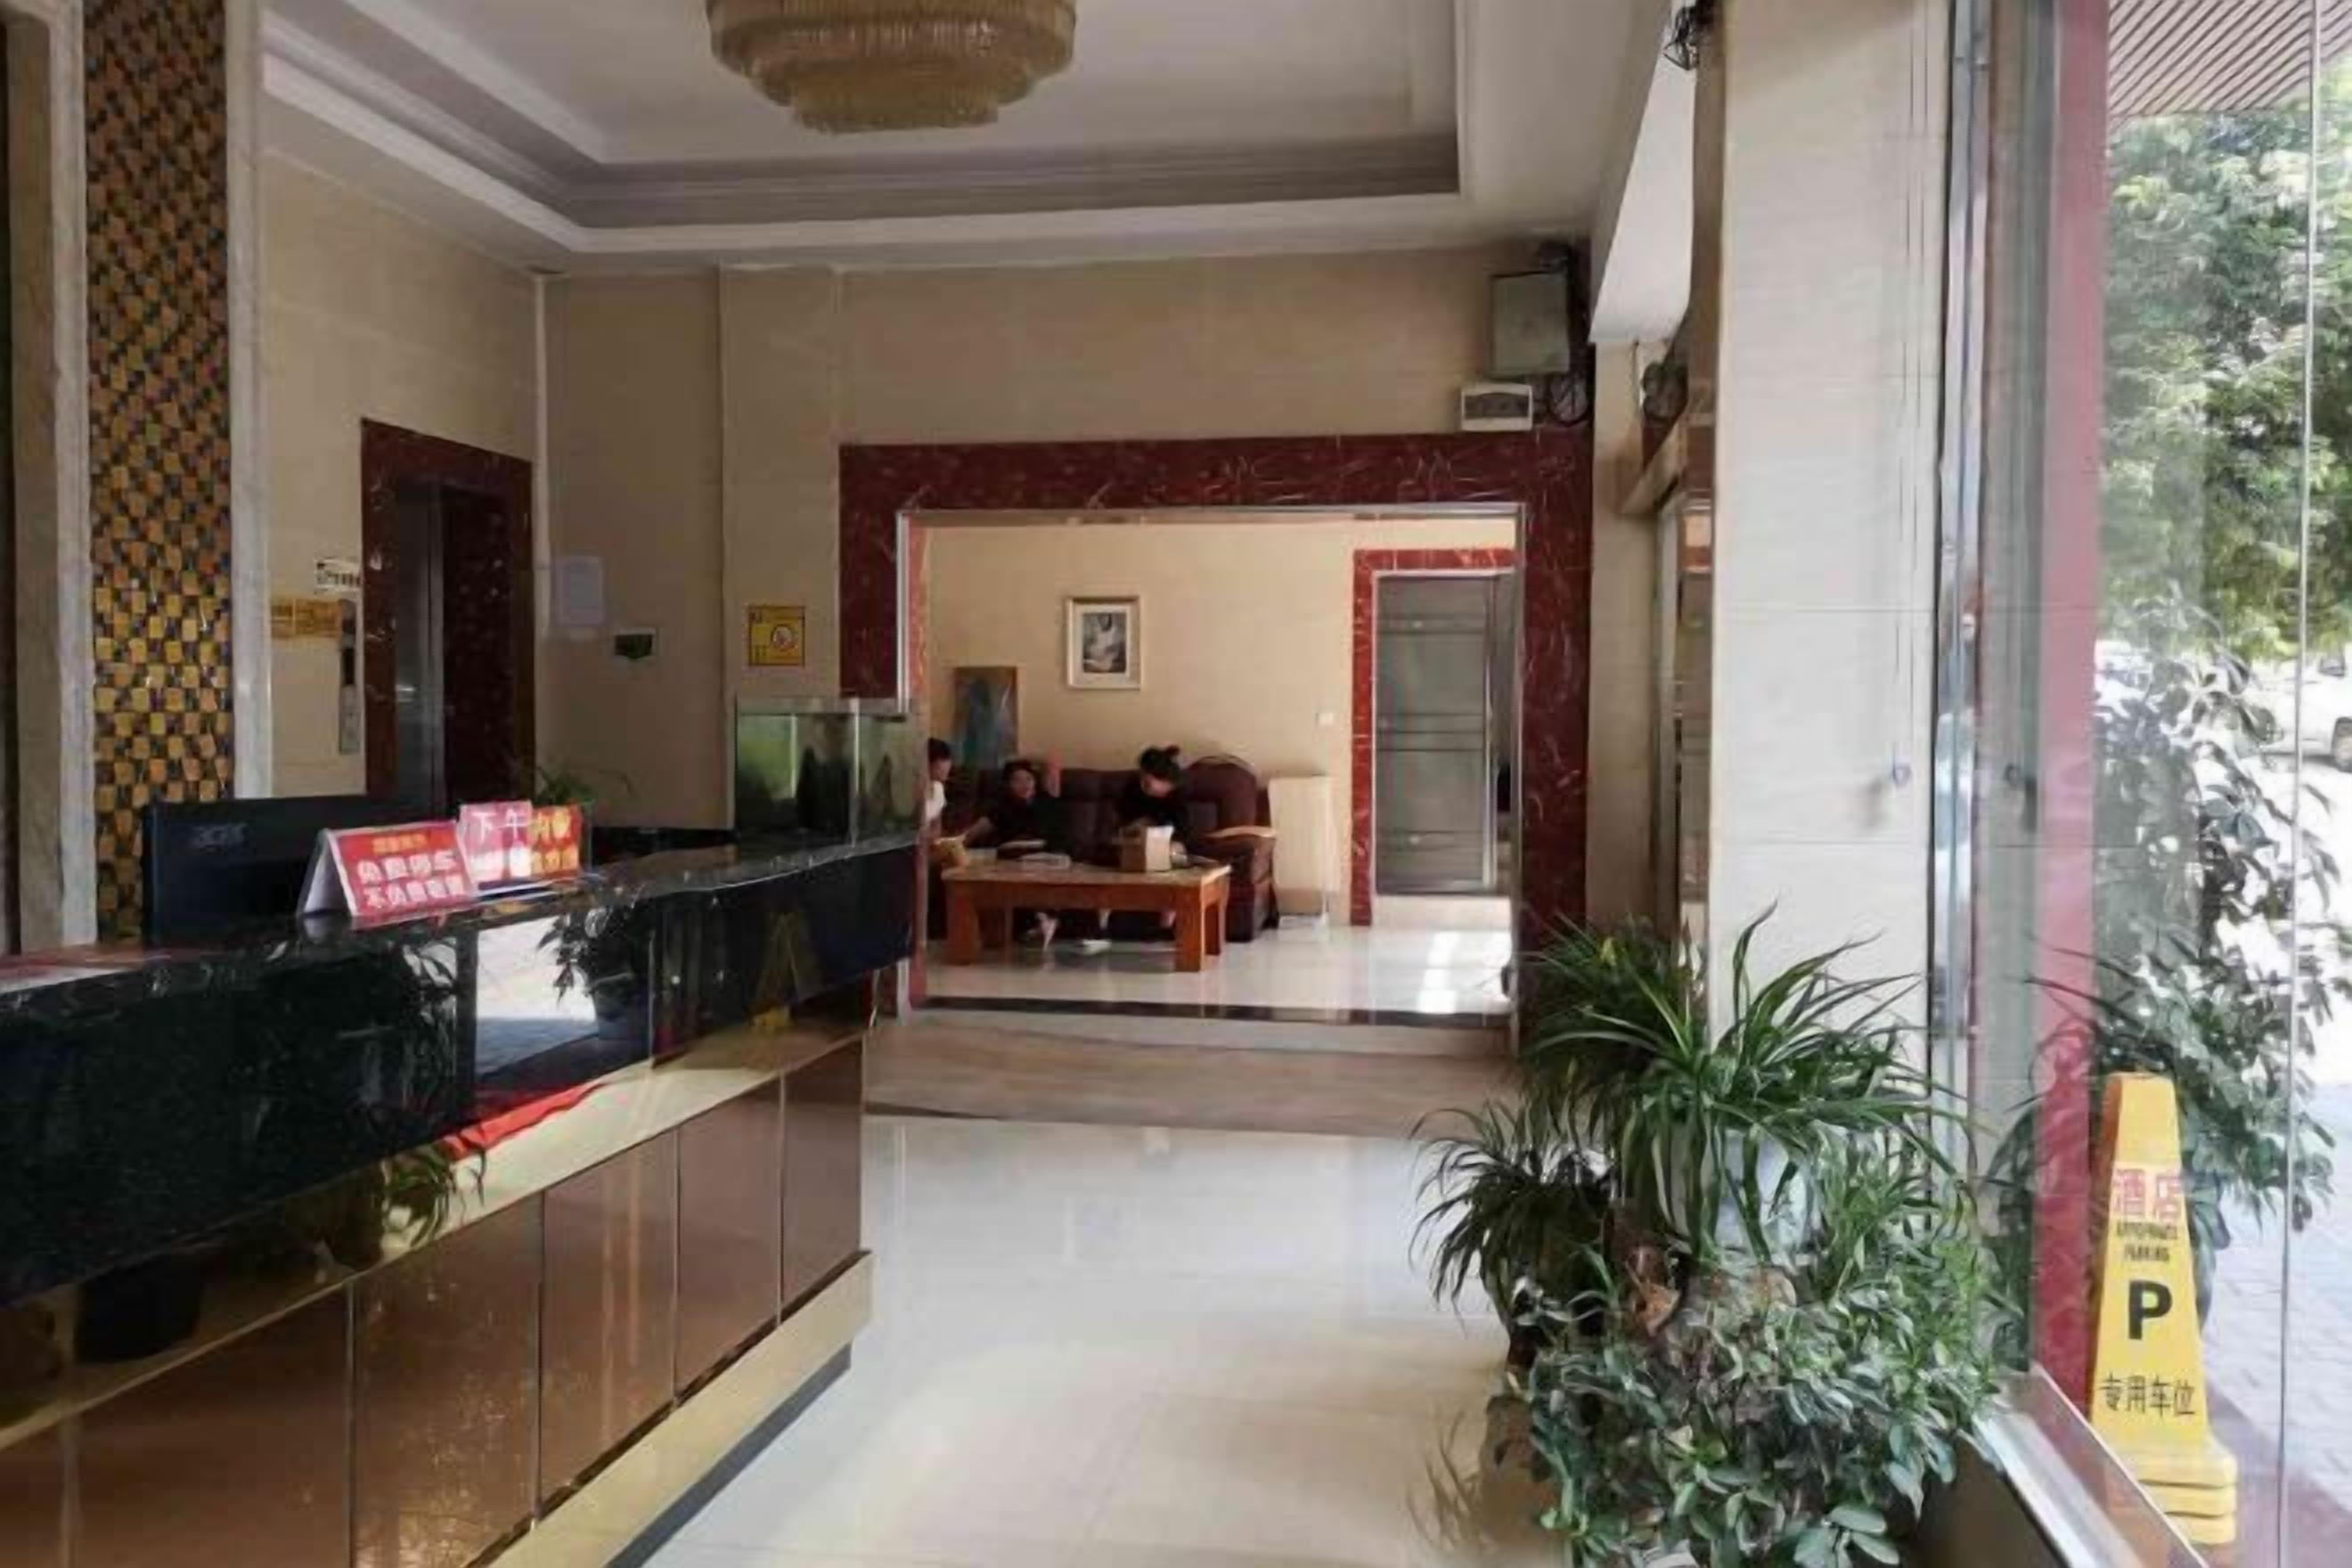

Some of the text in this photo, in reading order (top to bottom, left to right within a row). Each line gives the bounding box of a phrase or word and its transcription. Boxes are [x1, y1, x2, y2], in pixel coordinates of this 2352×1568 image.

[2128, 1280, 2173, 1340] P
[2099, 1373, 2195, 1418] 专用车位
